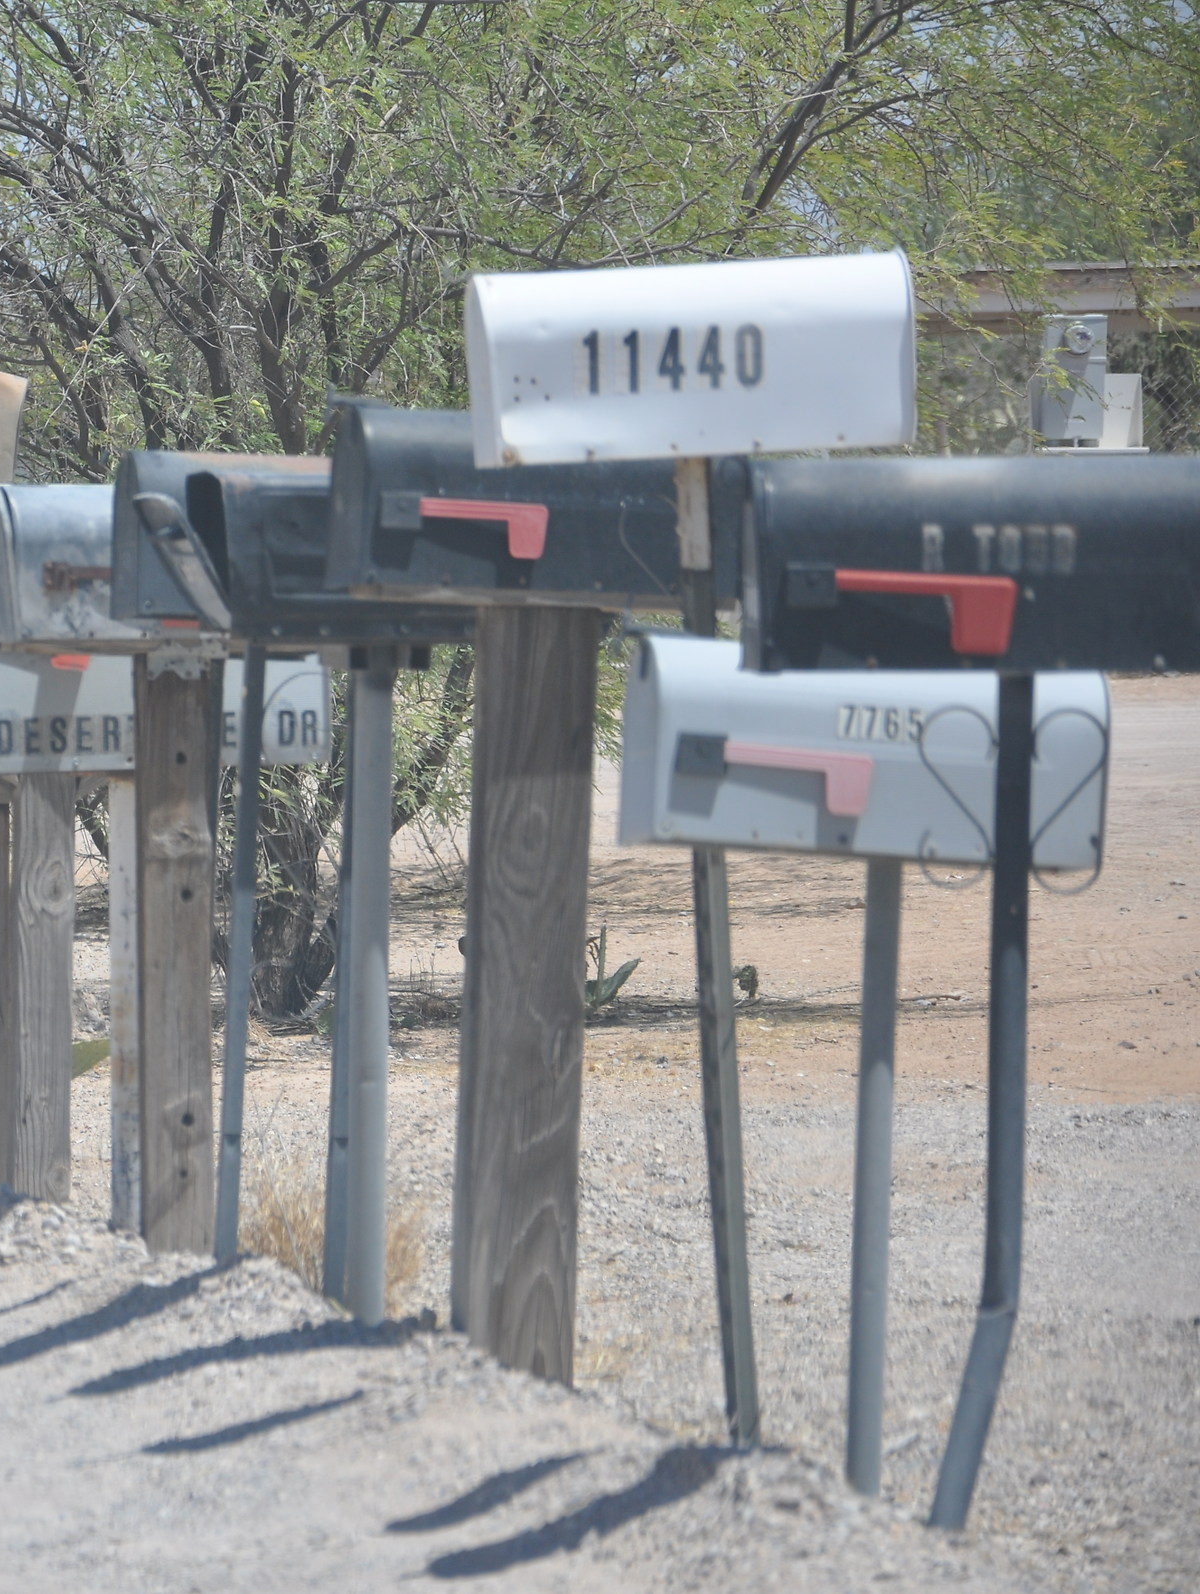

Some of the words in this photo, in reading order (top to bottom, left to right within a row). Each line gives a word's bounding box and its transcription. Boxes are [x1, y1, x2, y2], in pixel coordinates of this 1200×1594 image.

[582, 323, 764, 395] 11440
[278, 709, 318, 748] DR
[844, 704, 925, 743] 7765
